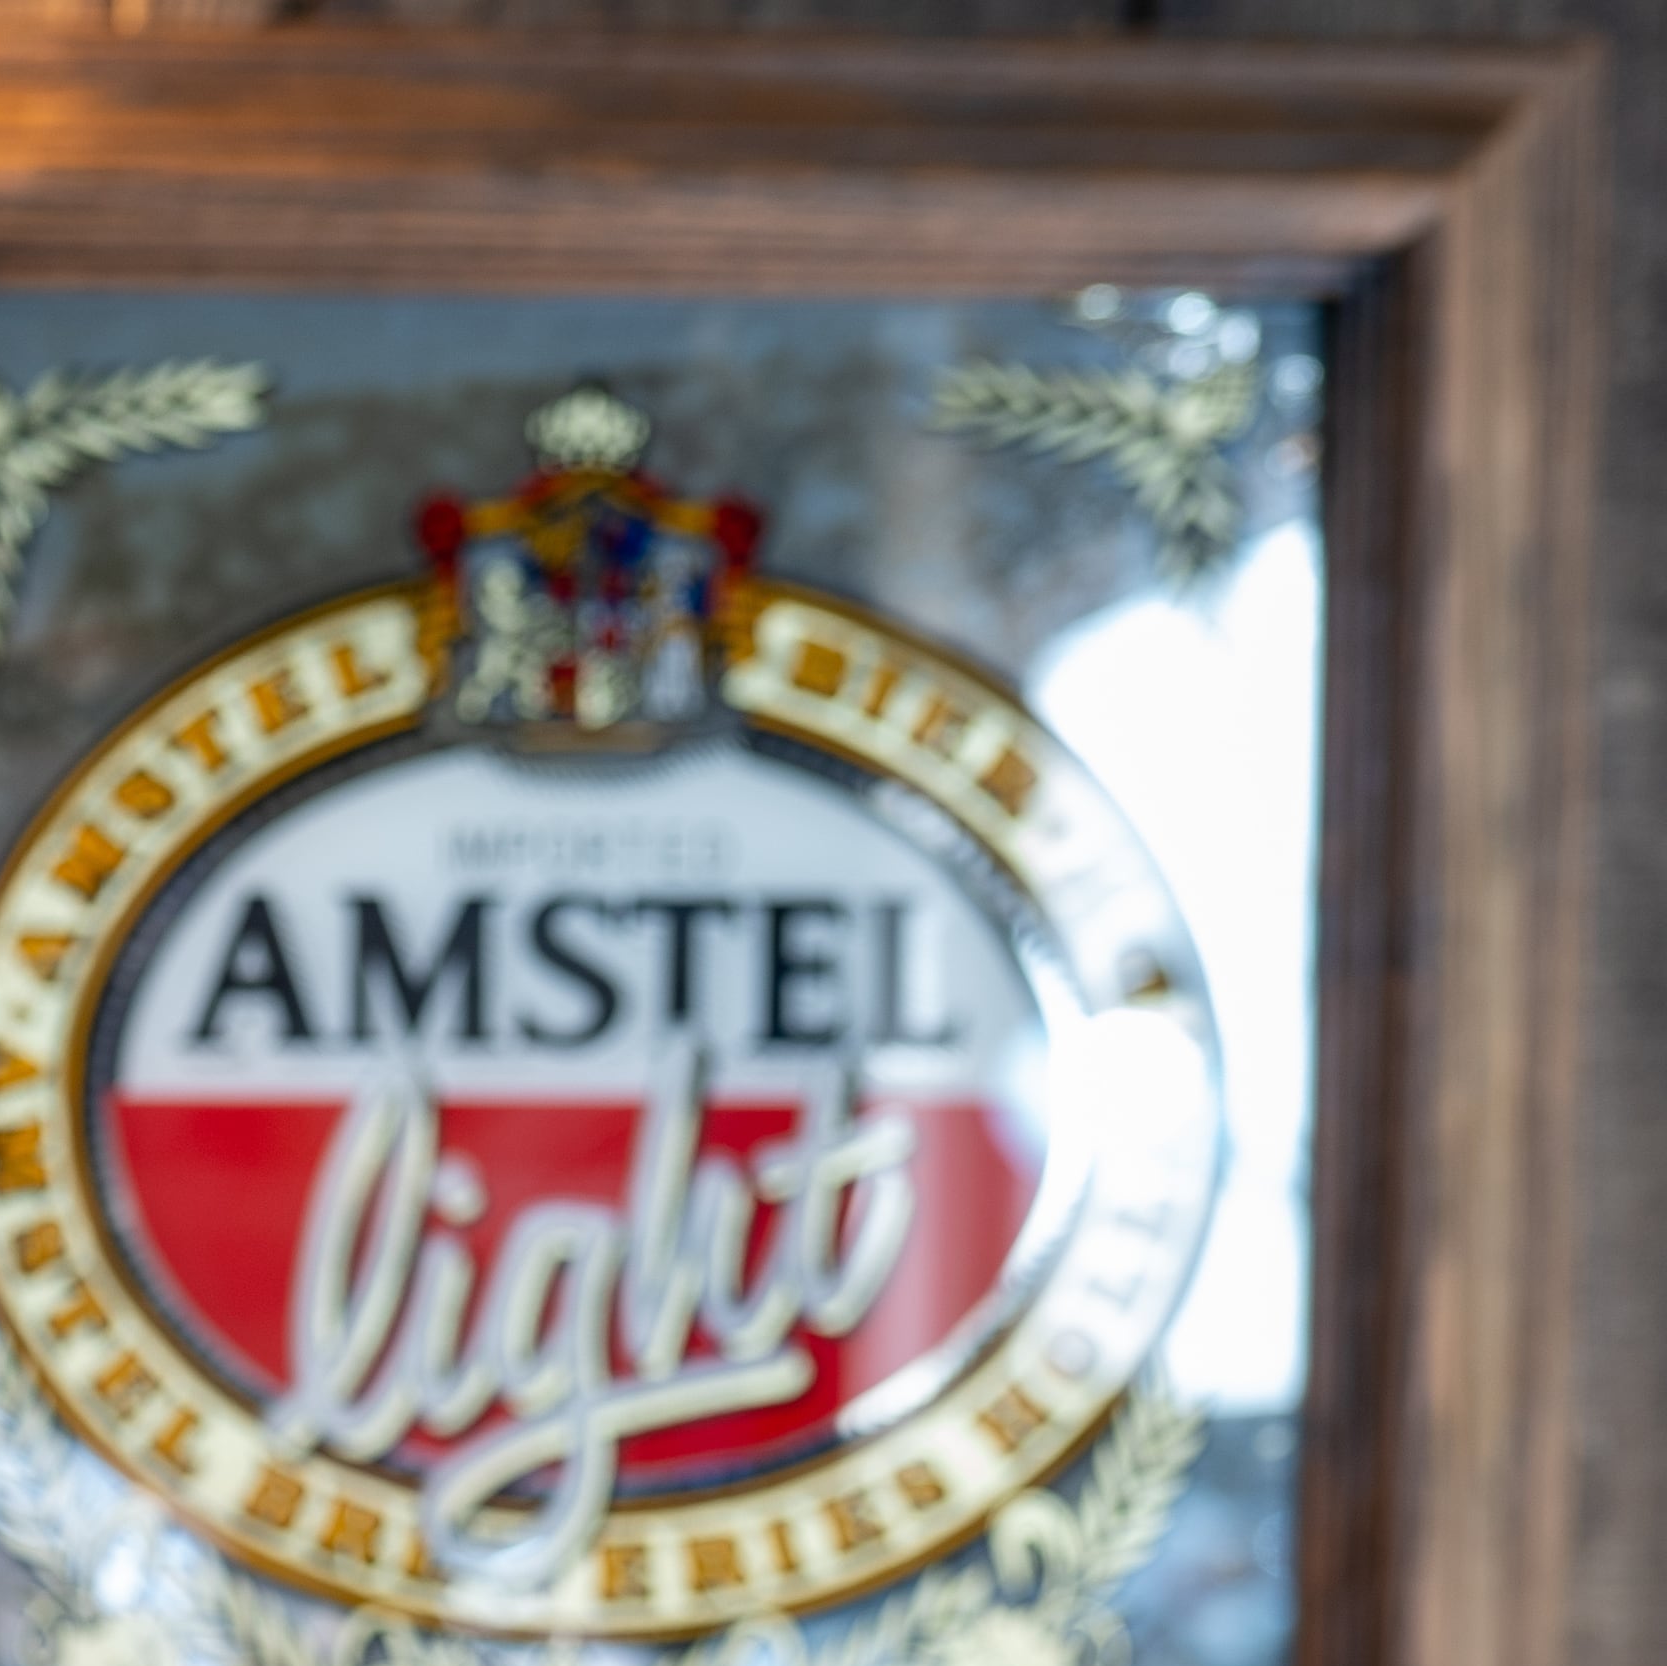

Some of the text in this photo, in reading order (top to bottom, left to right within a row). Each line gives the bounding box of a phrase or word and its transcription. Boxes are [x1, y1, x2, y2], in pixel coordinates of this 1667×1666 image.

[17, 641, 393, 982] AMSTEL
[187, 886, 962, 1050] AMSTEL
[267, 1032, 919, 1590] light
[246, 1462, 946, 1602] BRERIES
